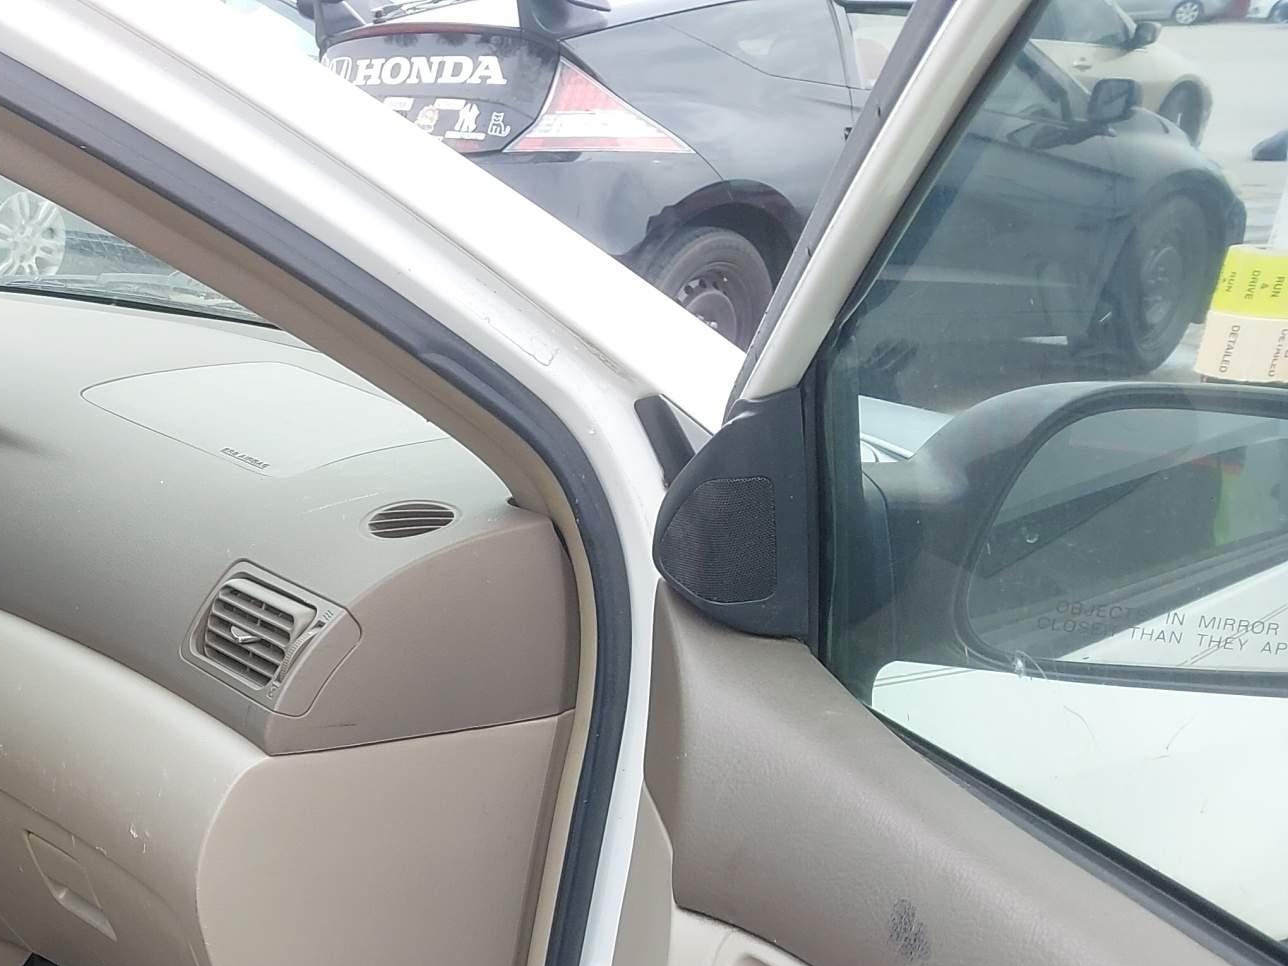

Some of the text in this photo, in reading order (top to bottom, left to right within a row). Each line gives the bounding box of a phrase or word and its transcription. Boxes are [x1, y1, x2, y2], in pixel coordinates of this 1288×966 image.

[351, 56, 507, 85] HONDA
[1244, 270, 1261, 300] DRIVE
[1271, 276, 1286, 298] RUN
[1219, 325, 1240, 374] DETAILED
[1165, 611, 1186, 626] IN
[1198, 615, 1280, 637] MIRROR
[1128, 625, 1183, 645] THAN
[1197, 633, 1249, 651] THEY
